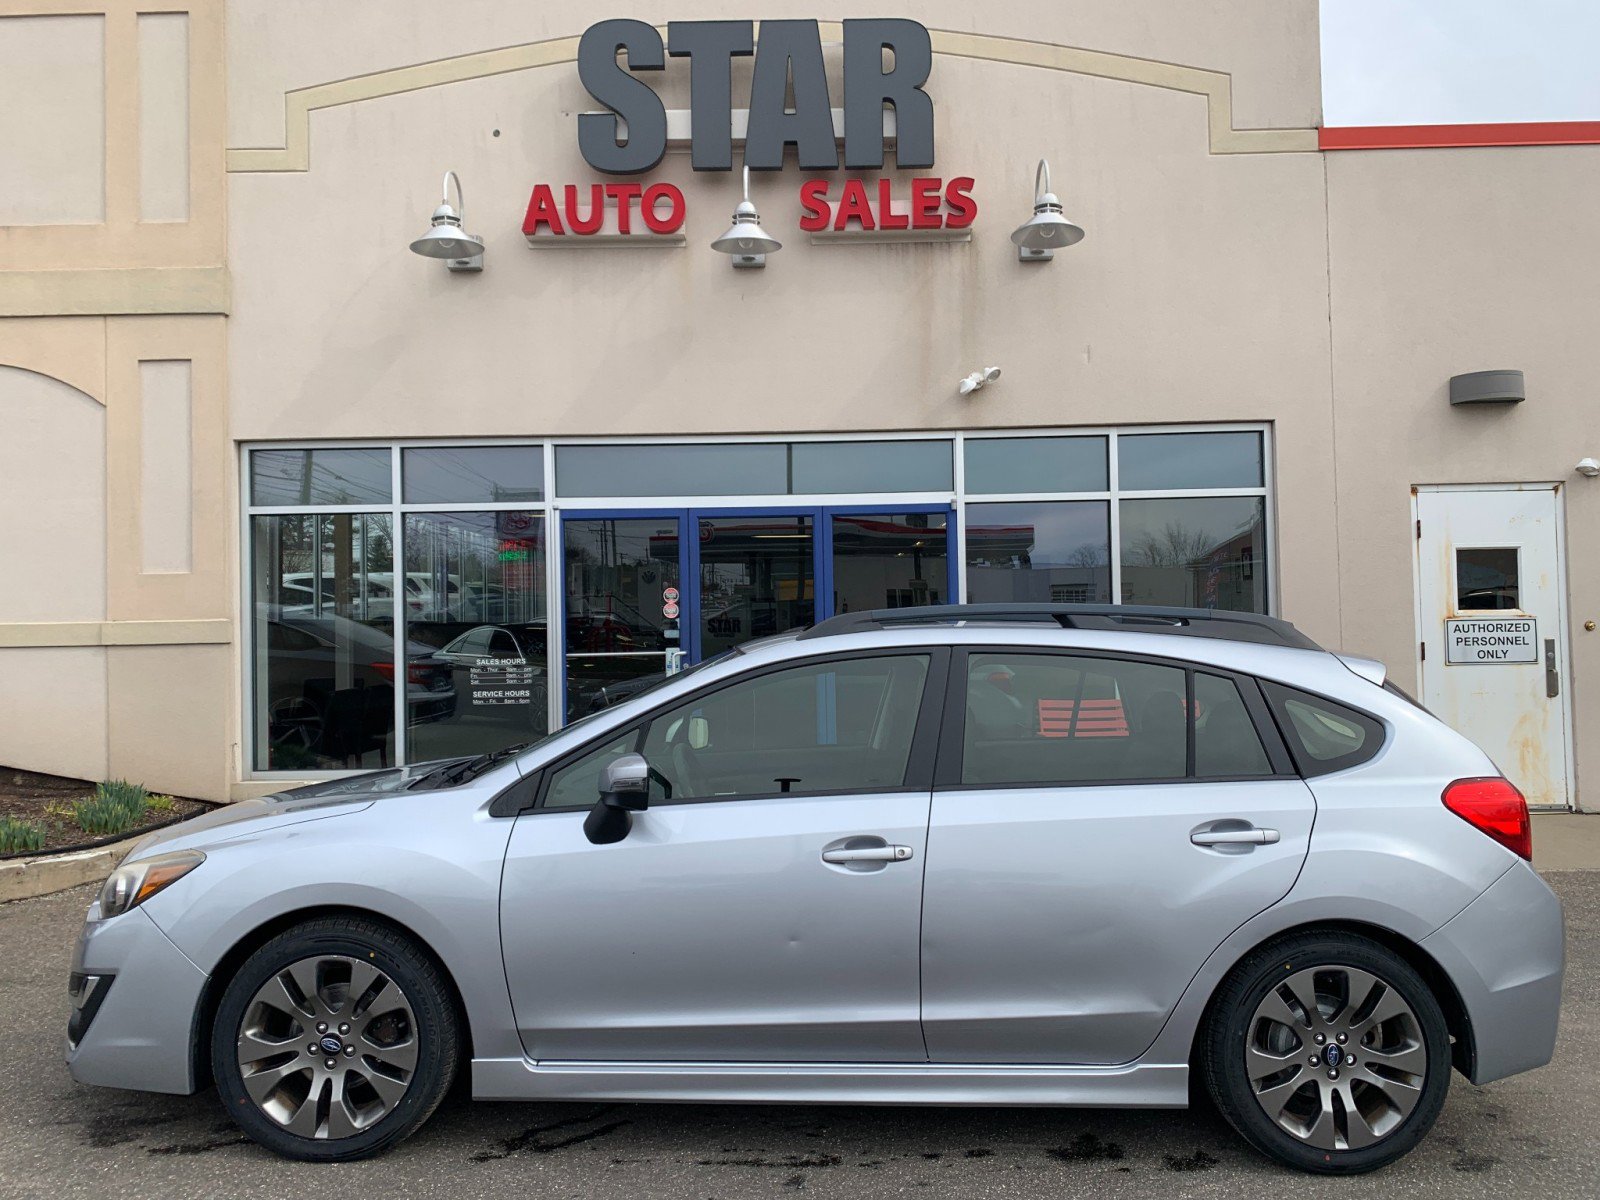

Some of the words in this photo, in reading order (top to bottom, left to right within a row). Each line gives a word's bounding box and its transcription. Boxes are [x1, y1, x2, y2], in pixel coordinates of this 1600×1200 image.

[577, 17, 935, 175] STAR
[522, 182, 686, 236] AUTO
[799, 176, 978, 232] SALES
[707, 617, 741, 633] STAR
[1453, 622, 1531, 634] AUTHORIZED
[1455, 635, 1530, 647] PERSONNEL
[1477, 648, 1509, 660] ONLY
